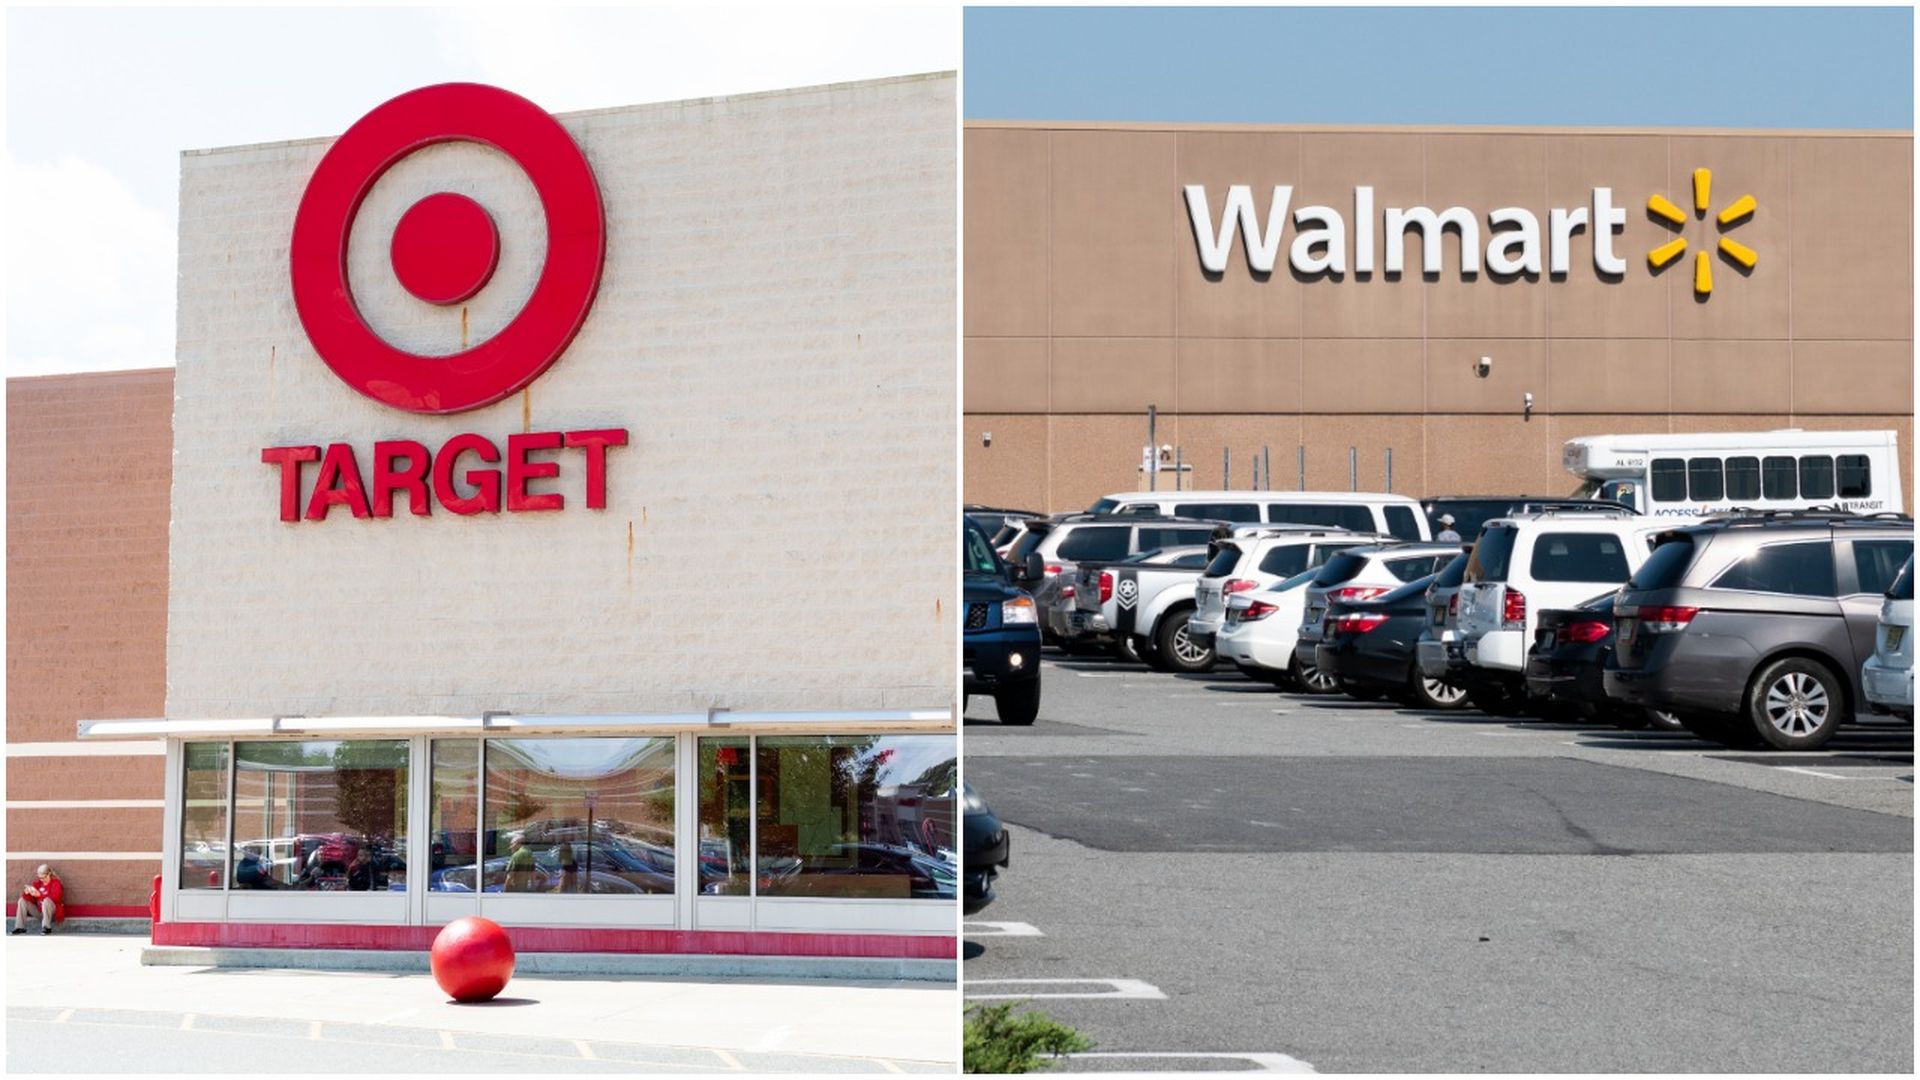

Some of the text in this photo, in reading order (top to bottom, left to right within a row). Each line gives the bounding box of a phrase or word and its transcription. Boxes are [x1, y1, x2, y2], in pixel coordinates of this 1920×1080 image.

[1184, 184, 1628, 277] Walmart
[261, 428, 629, 523] TARGET
[1654, 508, 1699, 517] ACCESS
[1850, 501, 1884, 509] TRANSIT
